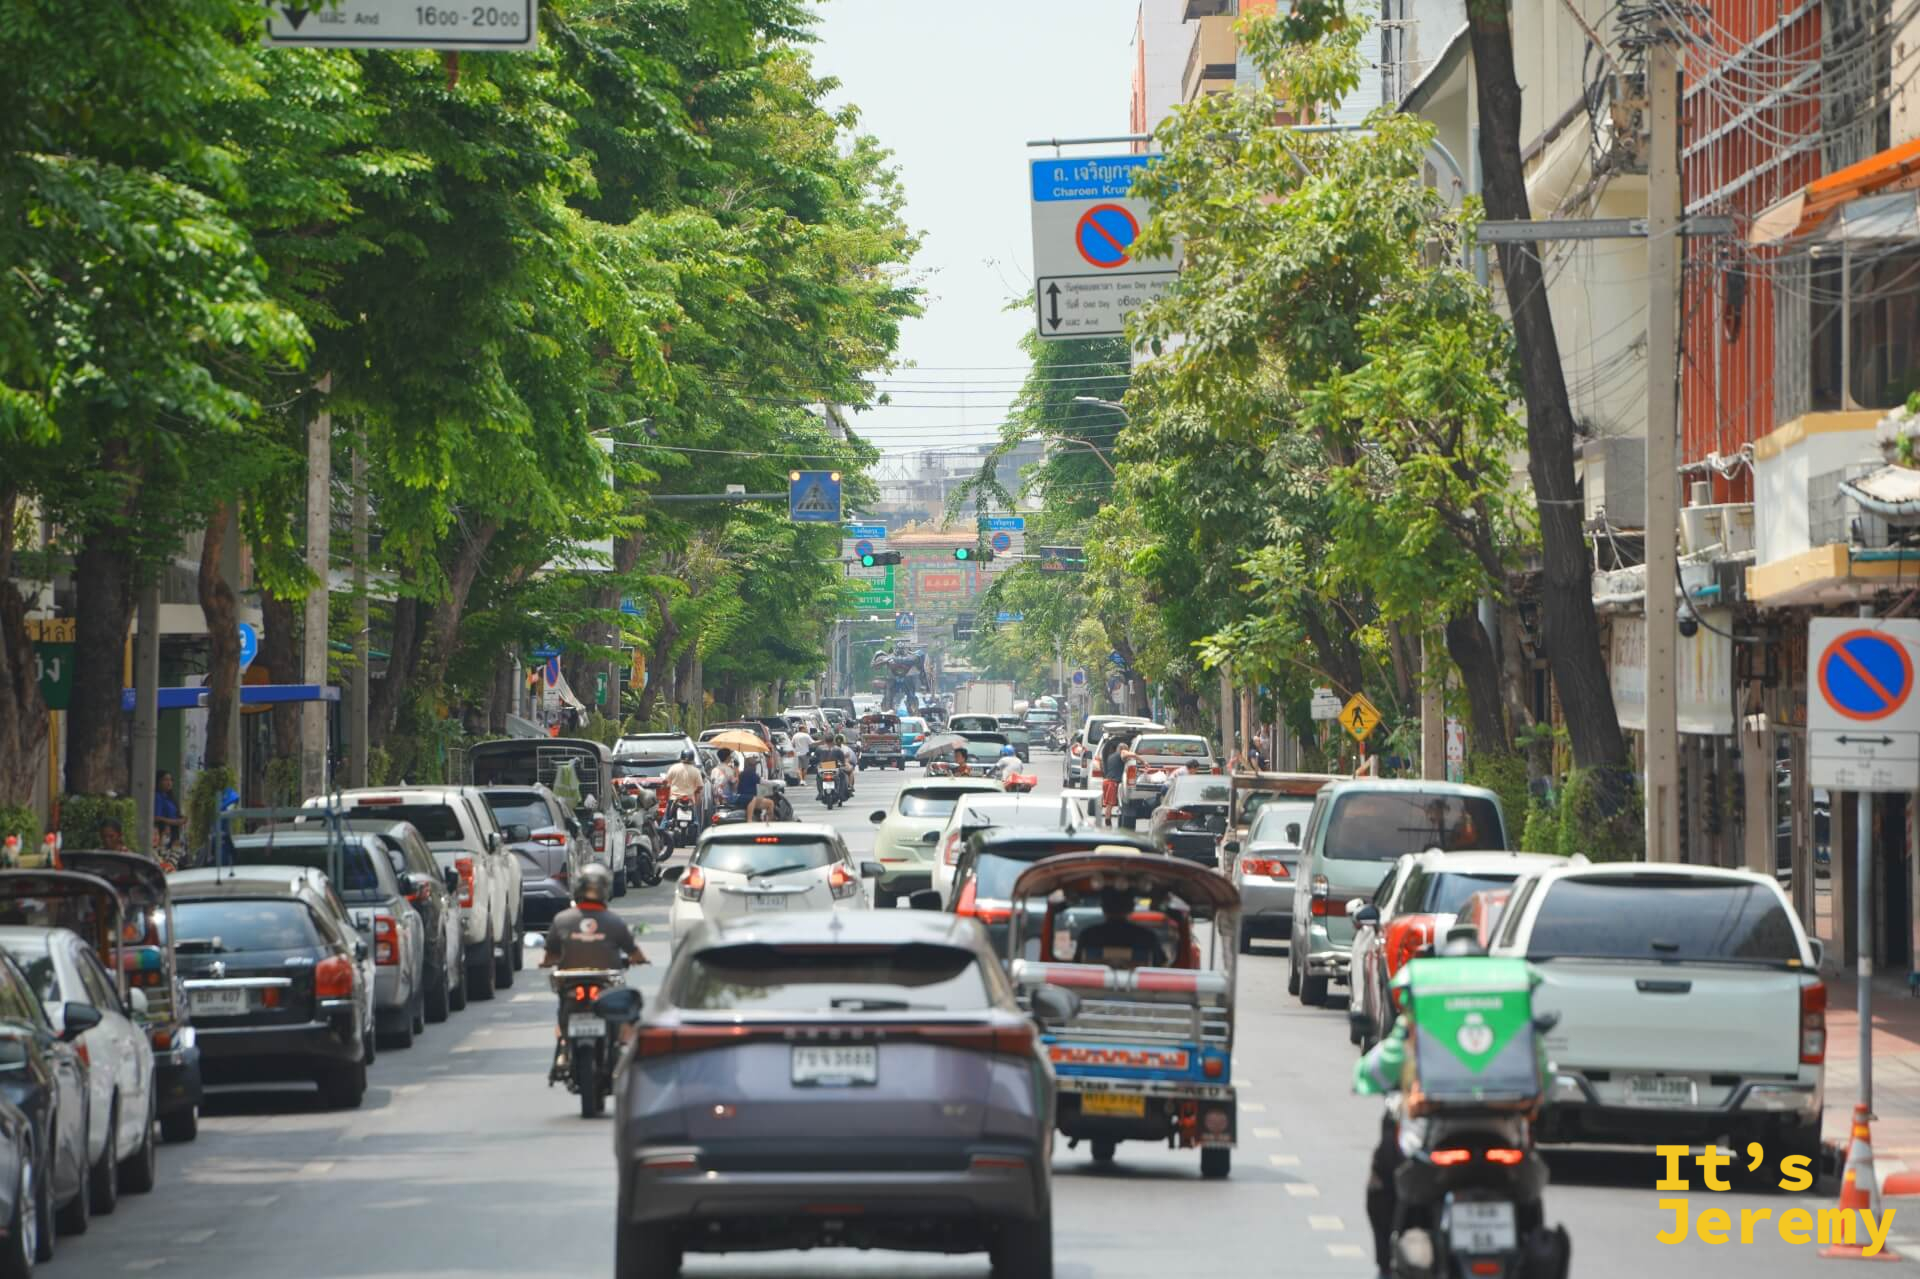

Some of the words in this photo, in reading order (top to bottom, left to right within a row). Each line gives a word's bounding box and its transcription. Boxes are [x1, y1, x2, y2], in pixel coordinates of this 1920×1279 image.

[354, 13, 379, 25] And
[1053, 186, 1098, 198] Charoen
[1102, 184, 1129, 196] Krun
